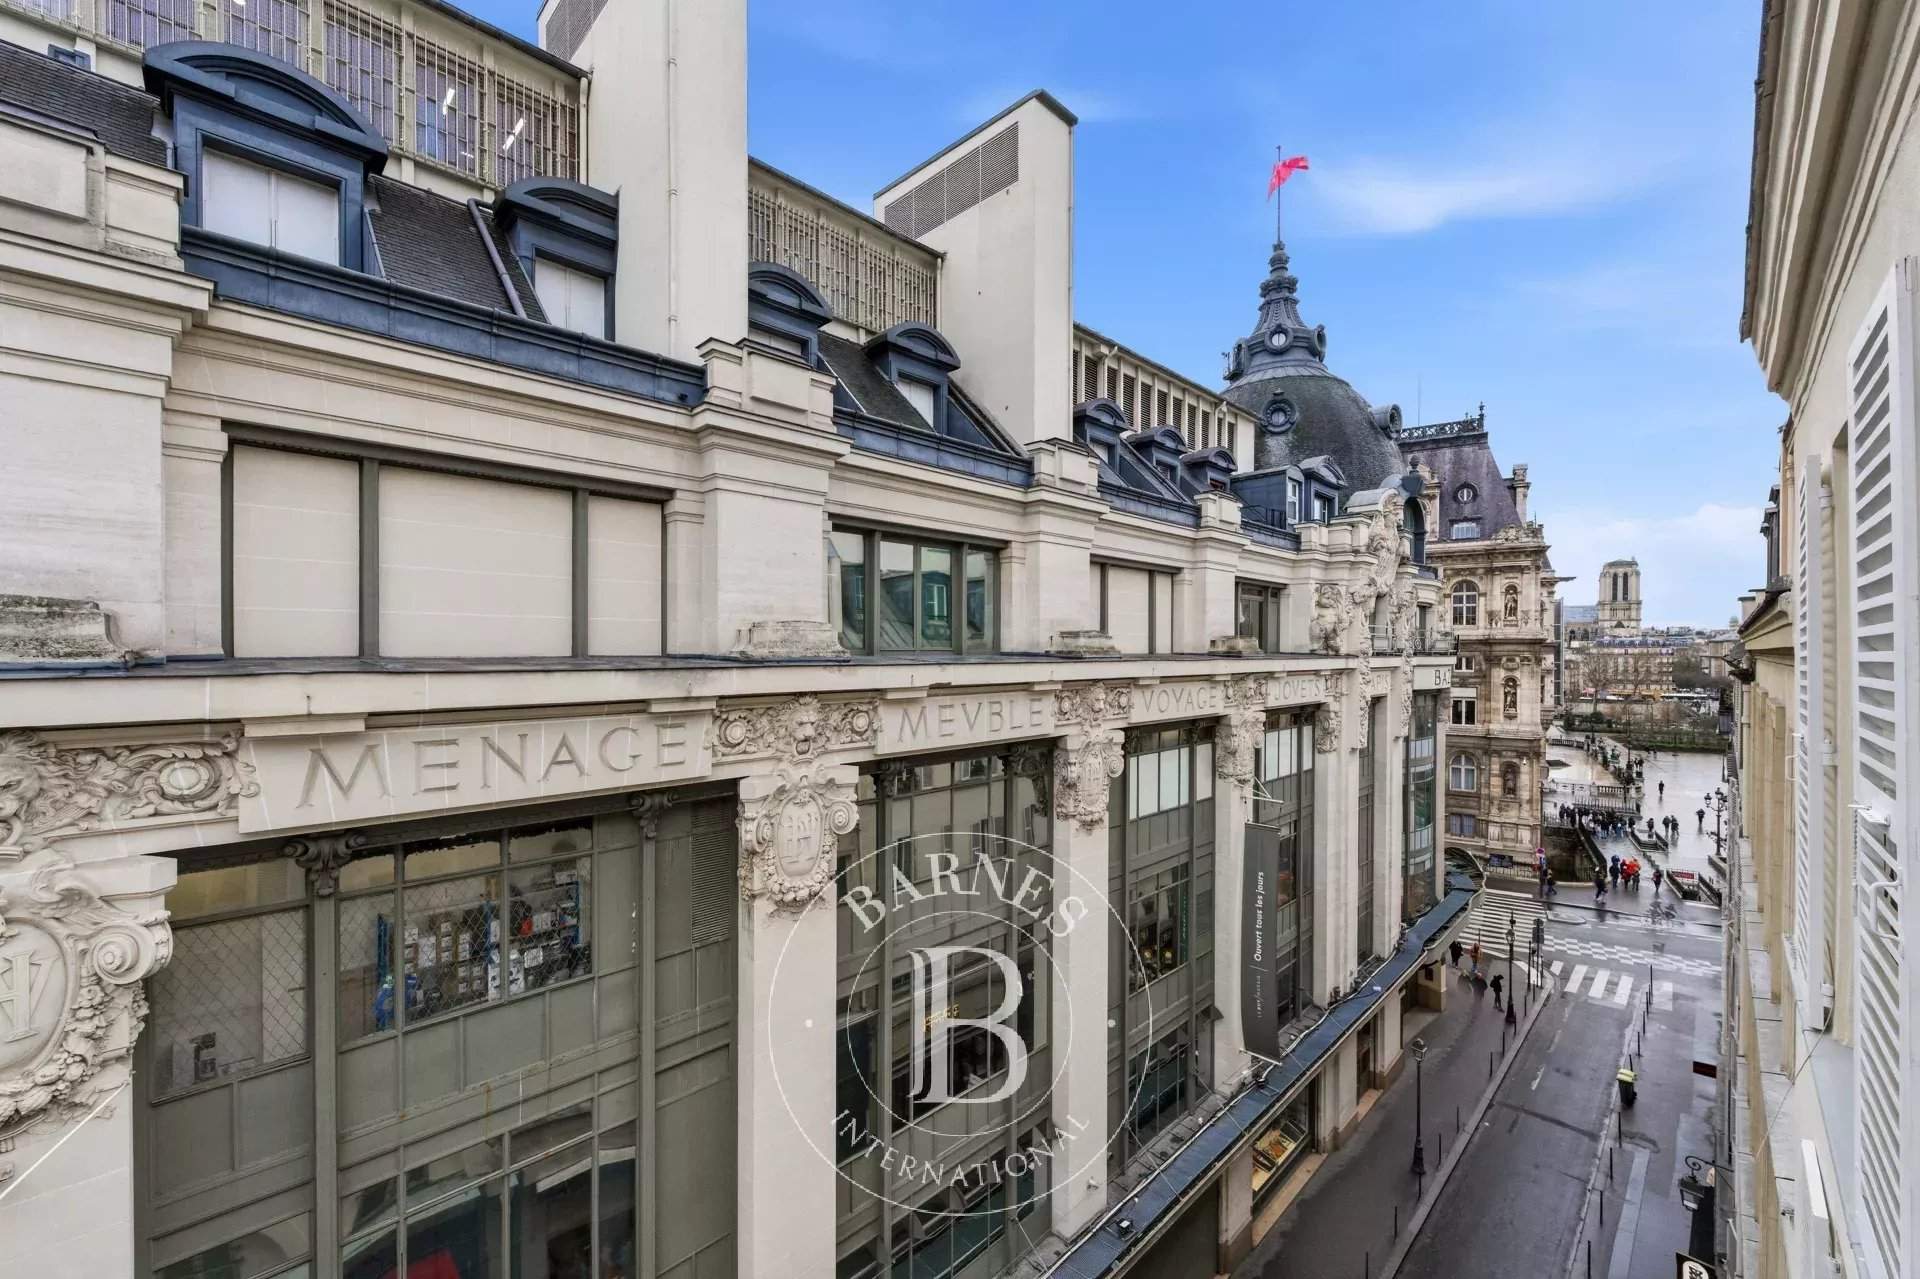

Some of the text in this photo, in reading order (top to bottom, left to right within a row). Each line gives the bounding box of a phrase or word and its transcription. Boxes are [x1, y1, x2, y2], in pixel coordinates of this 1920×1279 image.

[897, 698, 1043, 743] MEVBLE
[1141, 686, 1217, 713] VOYAGE
[295, 721, 688, 809] MENAGE
[1253, 871, 1265, 961] Ouvert tous les jours
